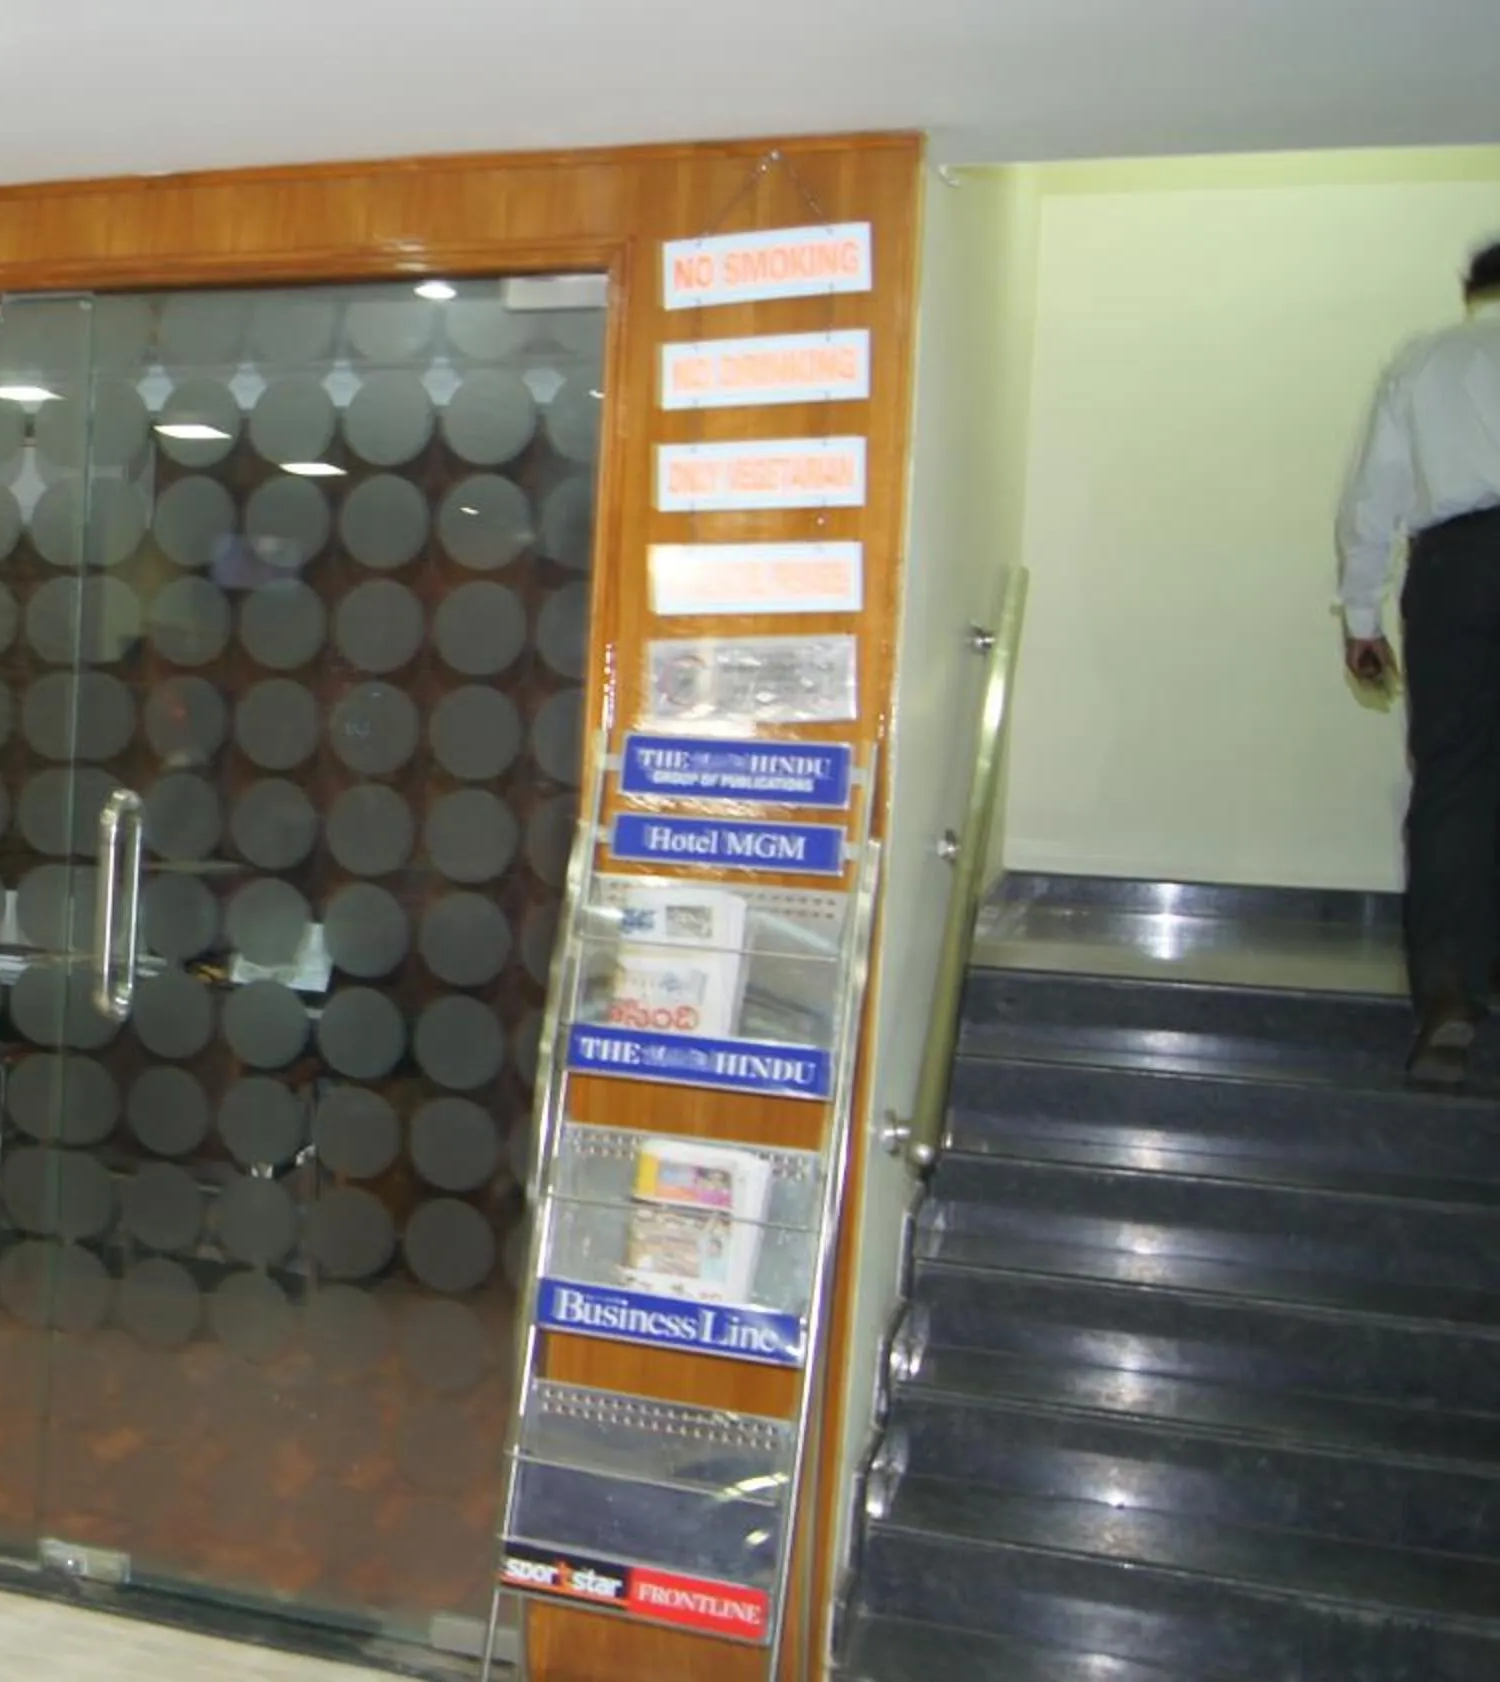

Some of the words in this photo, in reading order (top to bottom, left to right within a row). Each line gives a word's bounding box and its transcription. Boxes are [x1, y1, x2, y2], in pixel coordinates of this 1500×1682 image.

[673, 255, 713, 290] NO
[724, 241, 859, 284] SMOKING
[672, 357, 711, 392] NO
[638, 749, 690, 769] THE
[751, 754, 831, 779] HINDU
[650, 826, 719, 855] Hotel
[726, 833, 806, 861] MGM
[580, 1037, 641, 1066] THE
[714, 1052, 817, 1085] HINDU
[555, 1289, 698, 1342] Business
[700, 1309, 781, 1351] Line
[638, 1583, 761, 1625] FRONTLINE
